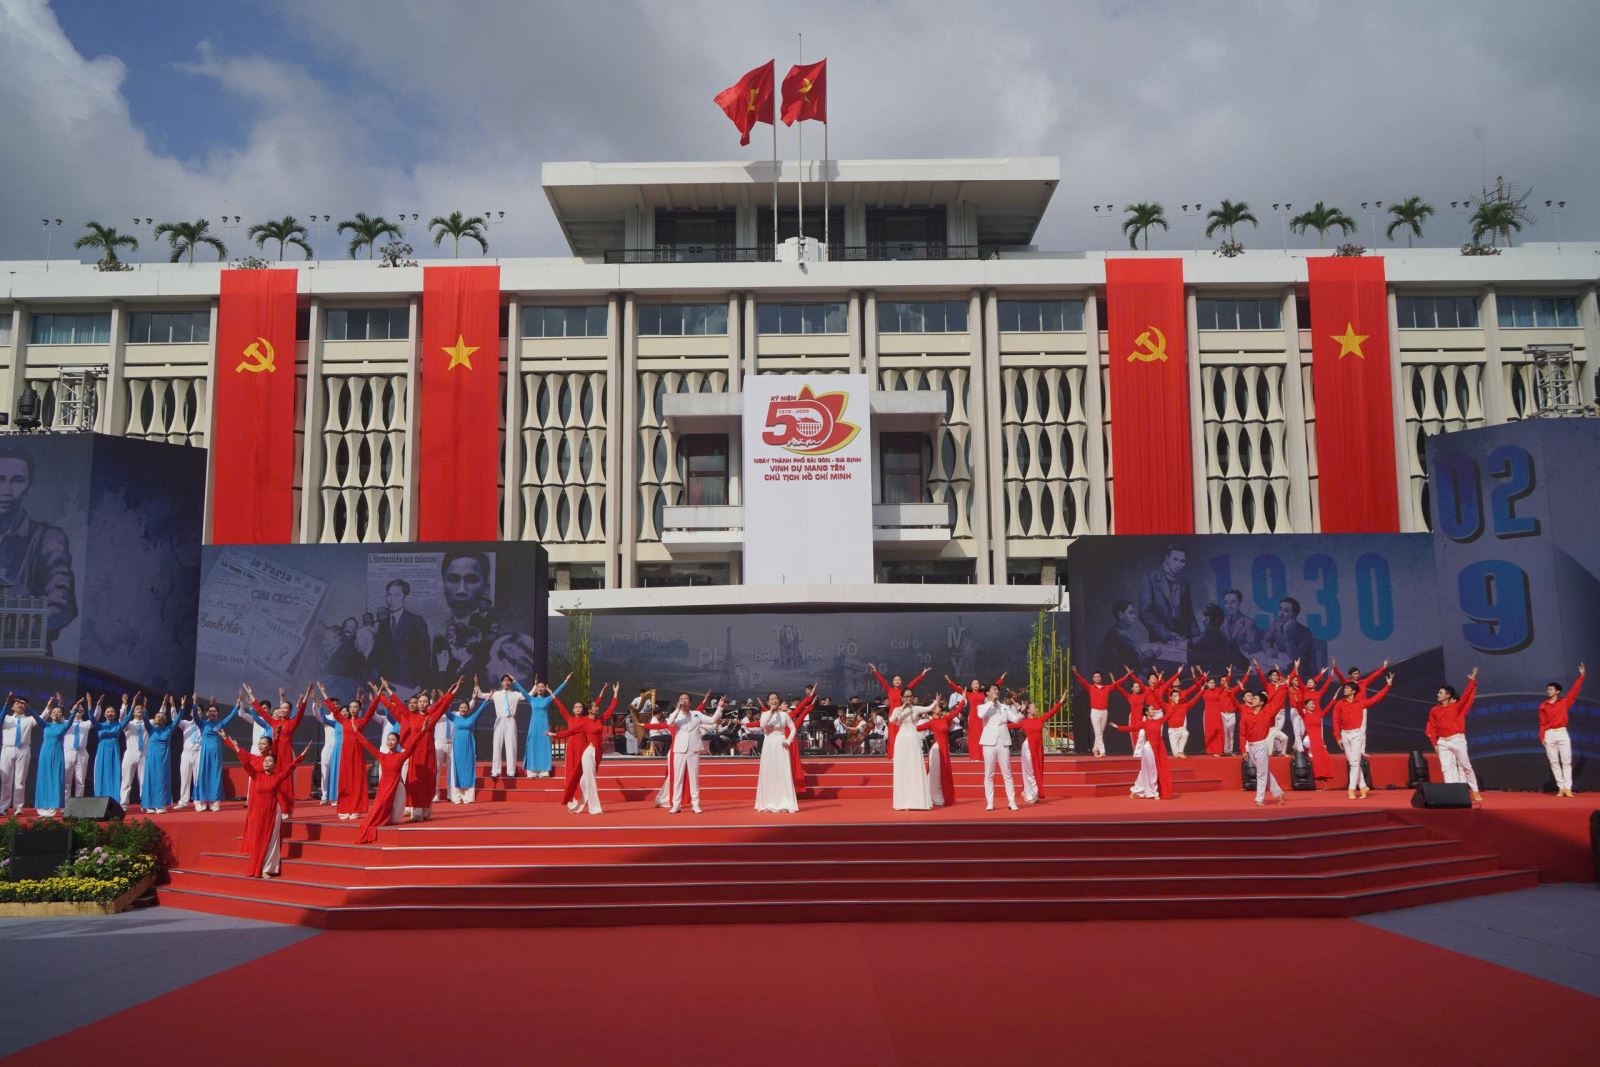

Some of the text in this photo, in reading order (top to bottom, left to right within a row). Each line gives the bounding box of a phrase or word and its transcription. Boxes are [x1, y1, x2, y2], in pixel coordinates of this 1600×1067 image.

[762, 402, 831, 446] 50
[764, 473, 781, 481] CHỦ
[783, 473, 800, 482] TỊCH
[802, 471, 813, 480] HỒ
[815, 472, 829, 480] CHÍ
[791, 465, 802, 473] DỤ
[830, 463, 846, 471] TÊN
[793, 455, 805, 463] PHỐ
[846, 456, 862, 464] ĐỊNH
[1435, 444, 1541, 543] 02
[1208, 552, 1394, 641] 1930
[1458, 559, 1535, 655] 9
